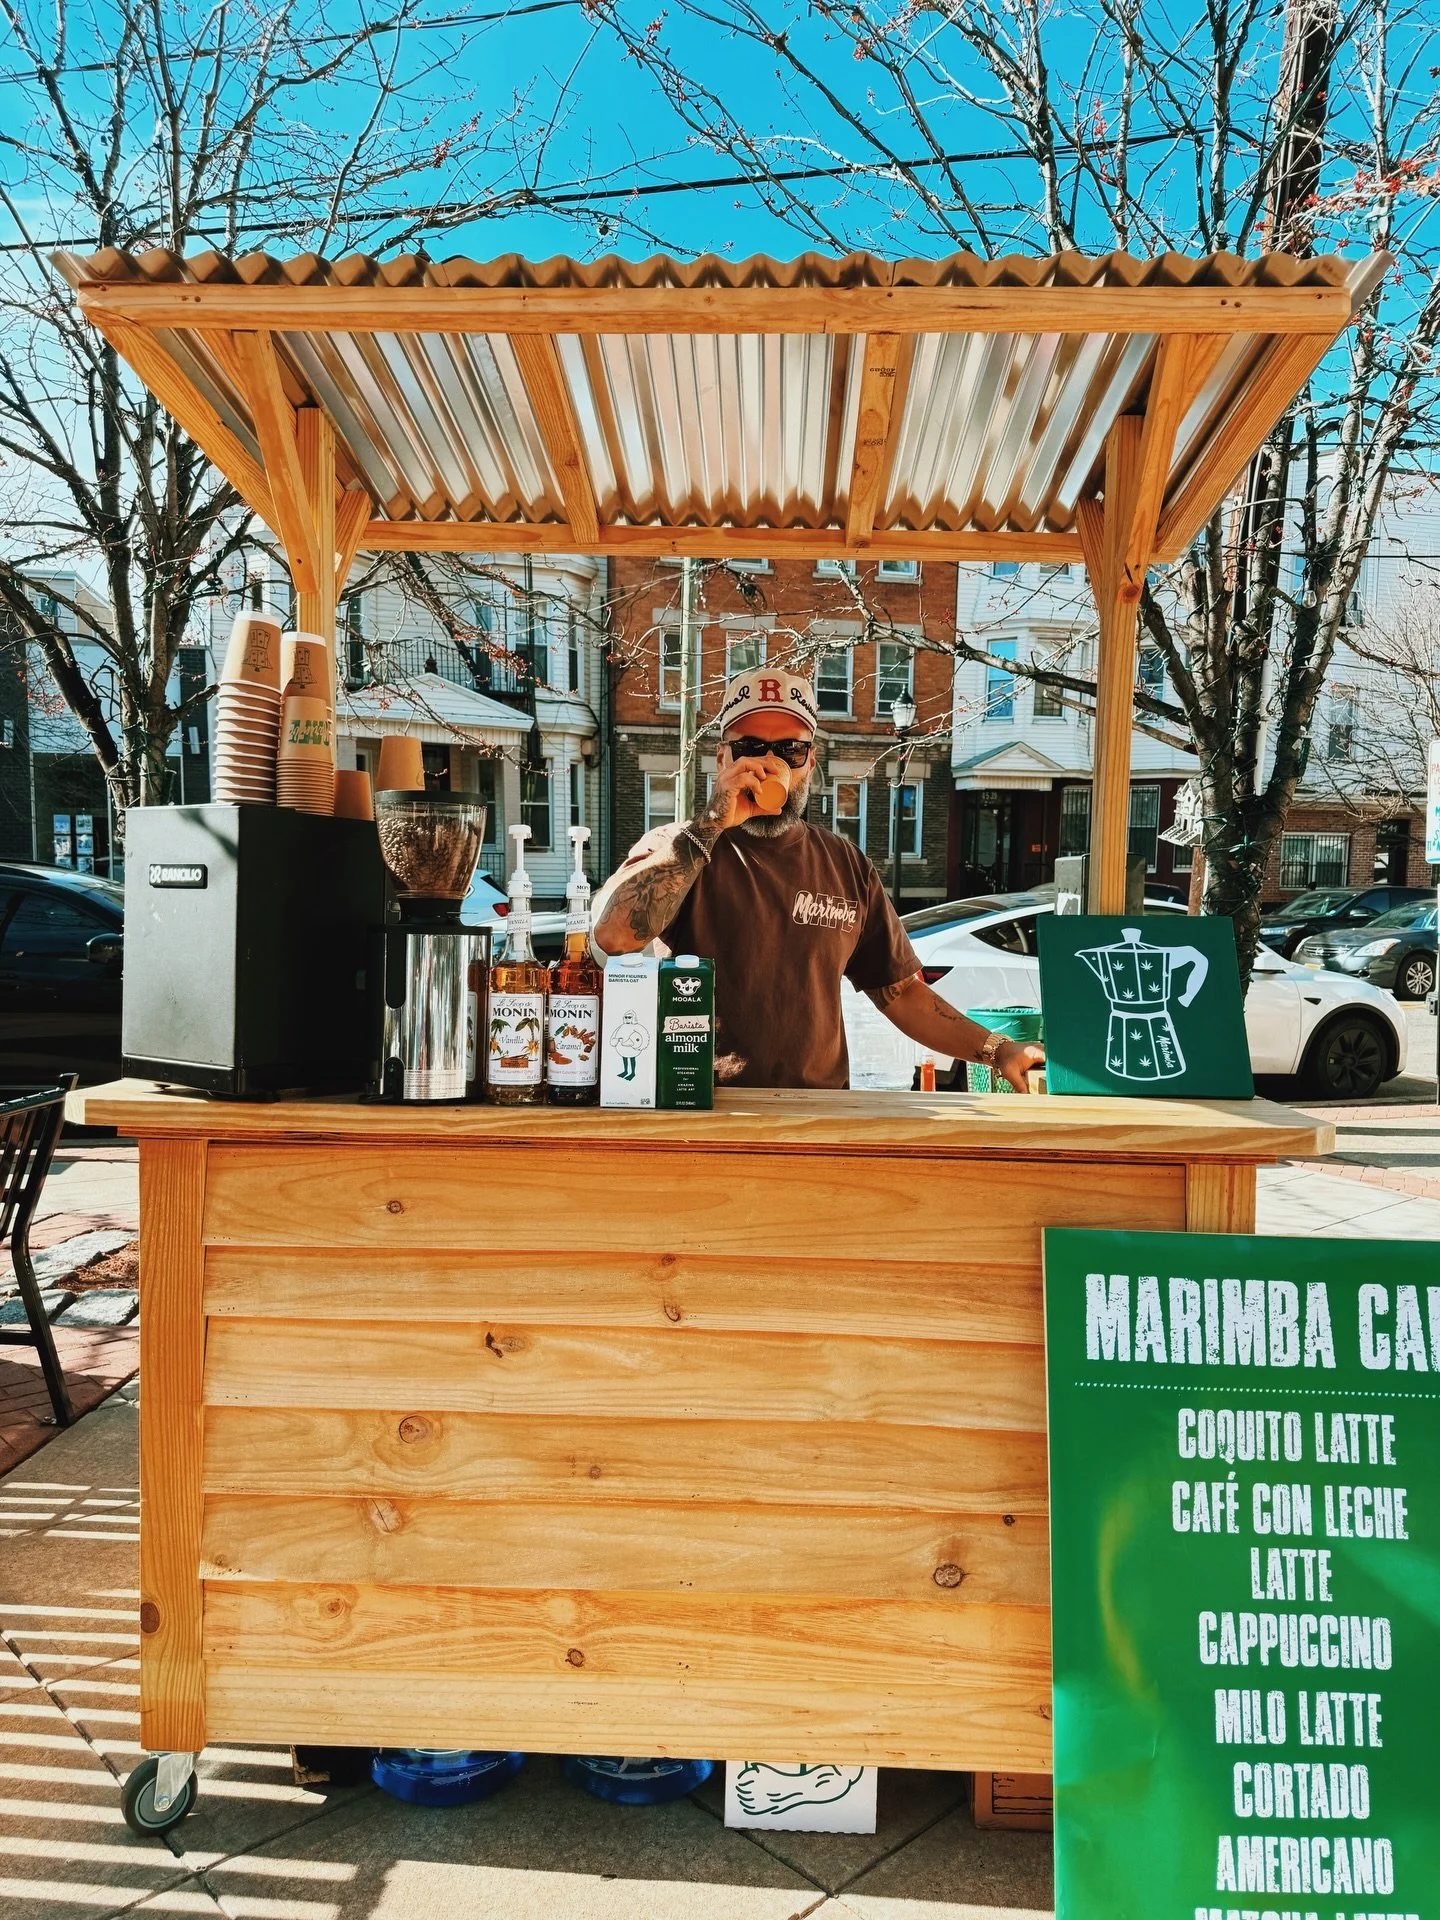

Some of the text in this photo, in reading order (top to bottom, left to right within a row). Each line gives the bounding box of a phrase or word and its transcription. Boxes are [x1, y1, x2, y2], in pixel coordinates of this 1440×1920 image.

[792, 893, 857, 923] Marimba
[493, 1008, 537, 1017] MONIN
[550, 1009, 592, 1019] MONIN
[665, 1033, 708, 1043] almond
[669, 1018, 706, 1031] Barista
[673, 1043, 699, 1053] milk
[1085, 1273, 1336, 1369] MARIMBA
[1178, 1408, 1397, 1466] COQUITO LATTE
[1172, 1471, 1409, 1540] CAFÉ CON LECHE
[1250, 1547, 1333, 1602] LATTE
[1199, 1611, 1393, 1671] CAPPUCCINO
[1214, 1689, 1383, 1748] MILO LATTE
[1233, 1762, 1370, 1820] CORTADO
[1216, 1835, 1394, 1895] AMERICANO
